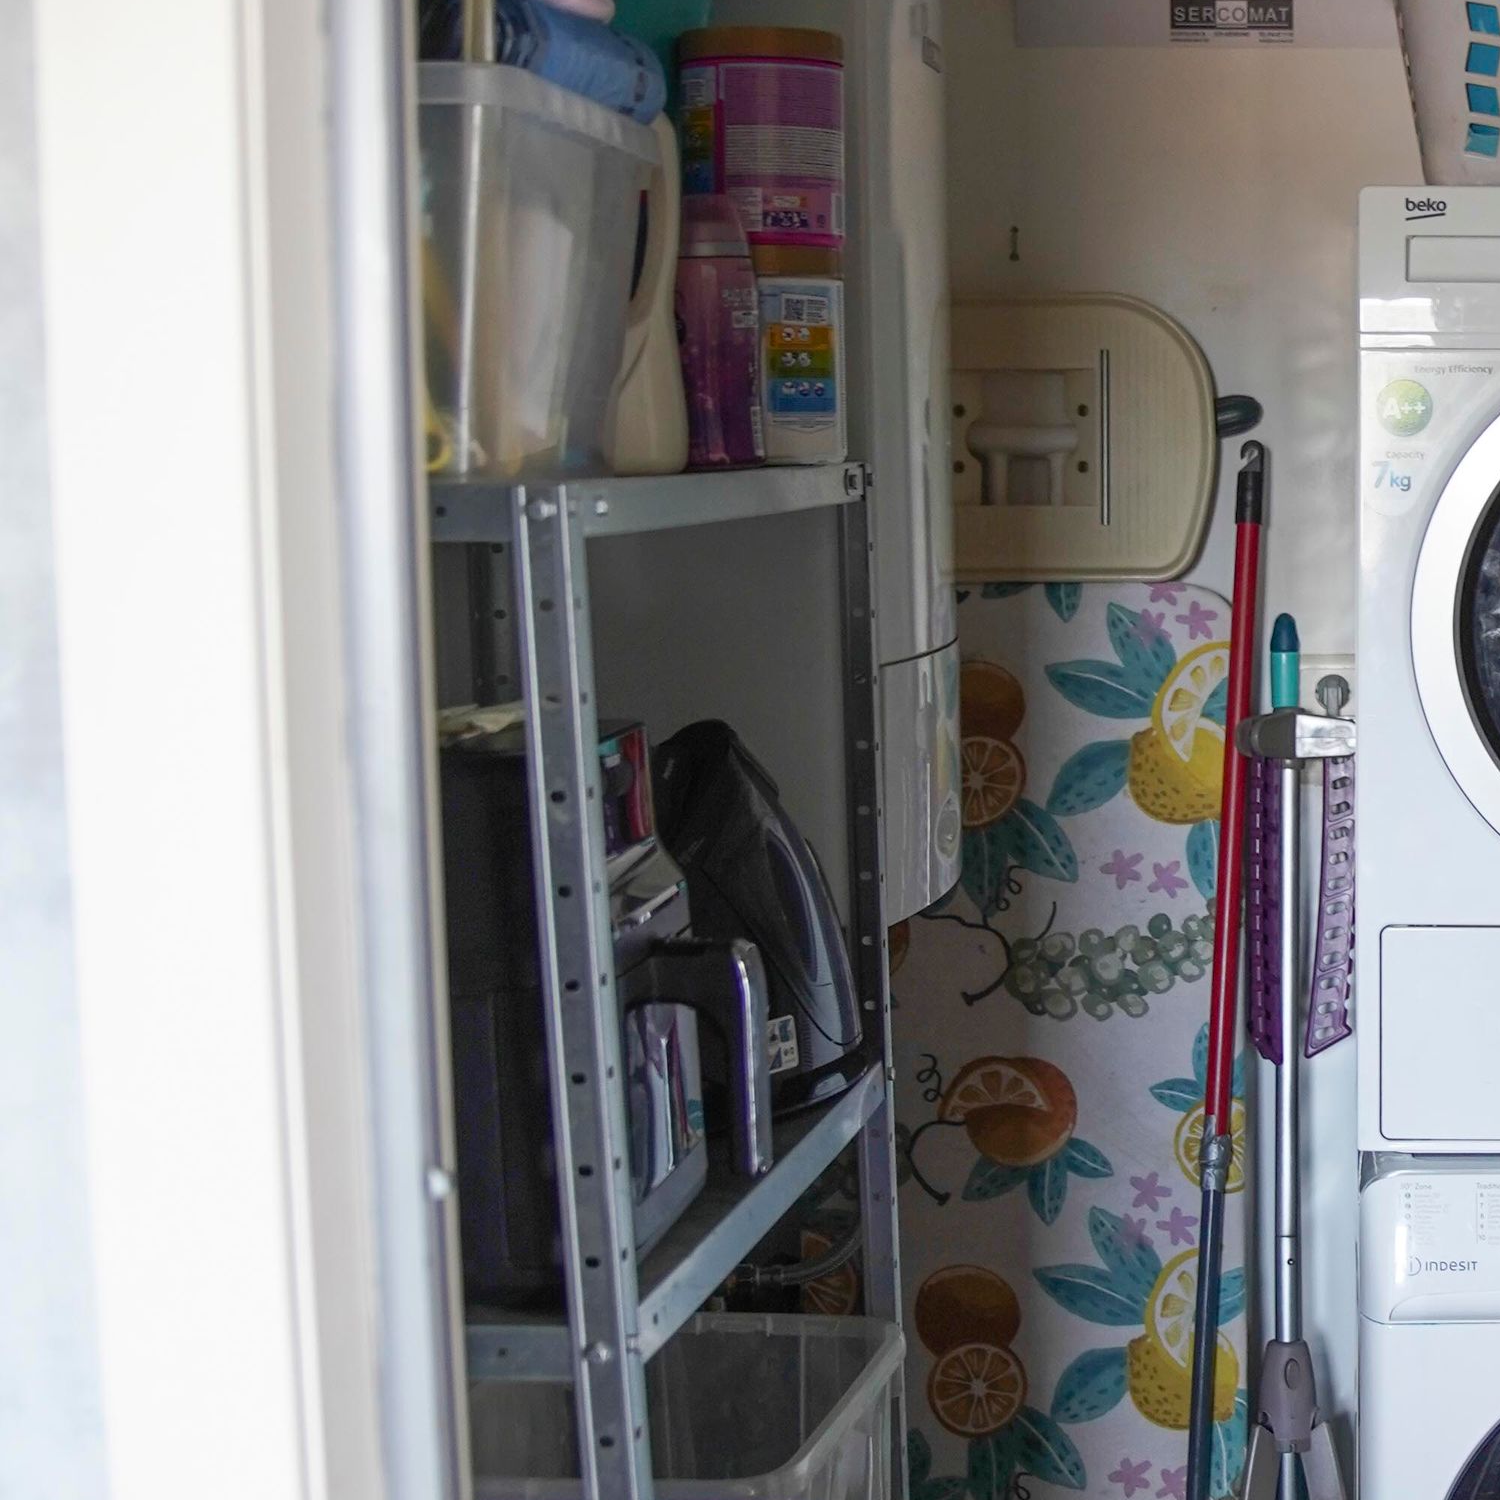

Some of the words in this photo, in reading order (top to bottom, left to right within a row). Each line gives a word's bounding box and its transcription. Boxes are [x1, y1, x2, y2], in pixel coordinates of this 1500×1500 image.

[1173, 6, 1289, 23] SERCOMAT
[1405, 198, 1447, 213] beko
[1414, 364, 1446, 375] Energy
[1448, 364, 1493, 375] Efficiency
[1383, 397, 1427, 419] A++
[1385, 450, 1425, 460] Capacity
[1415, 1182, 1432, 1190] Zone
[1425, 1260, 1478, 1272] INDESIT
